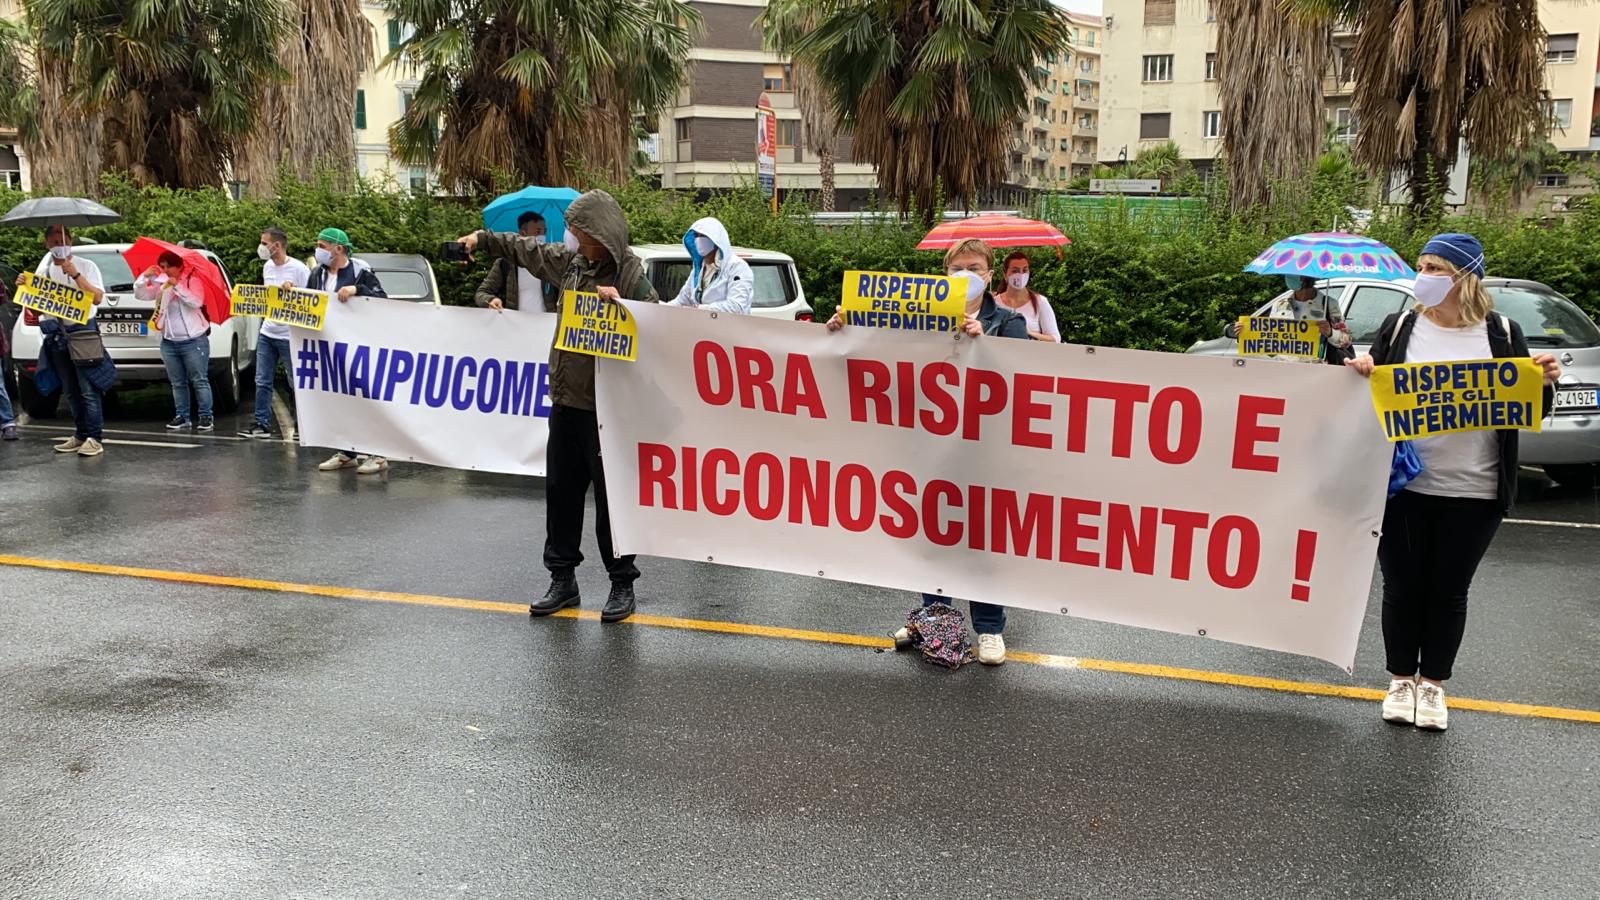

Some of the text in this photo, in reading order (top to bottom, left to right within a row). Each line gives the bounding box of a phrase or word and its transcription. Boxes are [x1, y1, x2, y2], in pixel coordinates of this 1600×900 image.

[31, 276, 84, 301] RISPETTO
[859, 274, 949, 302] RISPETTO
[19, 291, 85, 321] INFERMIERI
[38, 290, 73, 306] PER GLI
[277, 288, 320, 307] RISPETTO
[283, 302, 297, 310] PER
[872, 300, 931, 313] PER GLI
[233, 303, 268, 315] INFERMI
[270, 307, 321, 328] INFERMIERI
[106, 322, 140, 334] 518YR
[582, 317, 618, 332] PER GLI
[1250, 317, 1309, 333] RISPETTO
[563, 327, 633, 357] INFERMIERI
[1260, 331, 1279, 340] PER
[1243, 339, 1314, 356] INFERMIERI
[1392, 361, 1519, 395] RISPETTO
[693, 340, 1286, 473] ORA RISPETTO E
[1416, 389, 1496, 406] PER GLI
[1383, 400, 1533, 438] INFERMIERI
[637, 441, 1318, 603] RICONOSCIMENTO !
